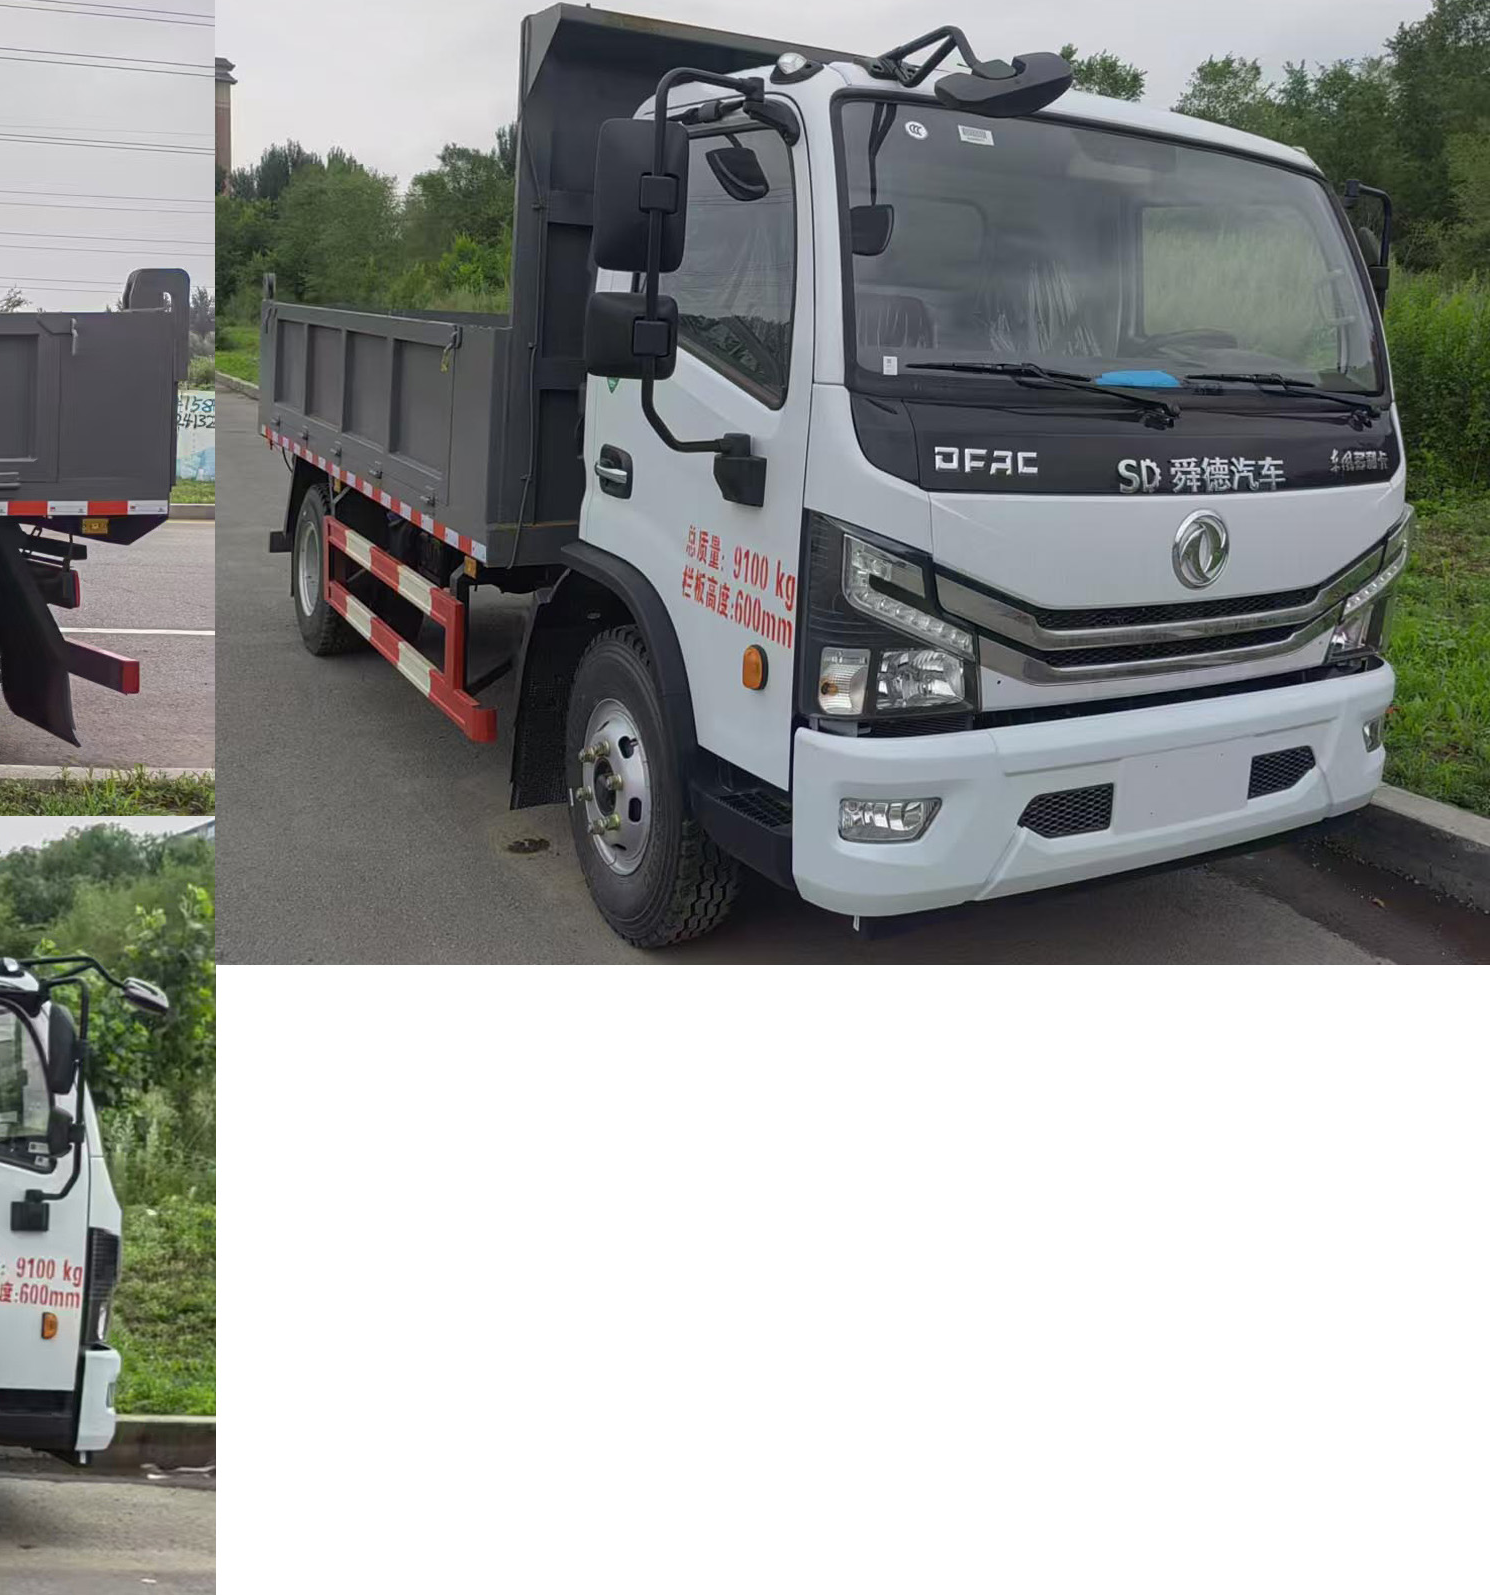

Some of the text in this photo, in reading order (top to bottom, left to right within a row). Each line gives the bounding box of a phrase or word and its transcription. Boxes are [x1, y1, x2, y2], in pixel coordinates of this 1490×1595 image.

[934, 446, 1039, 475] DFAC
[1117, 456, 1286, 494] SD 舜德汽车
[733, 545, 769, 591] 9100
[775, 560, 795, 611] kg
[16, 1257, 56, 1280] 9100
[63, 1259, 83, 1287] kg
